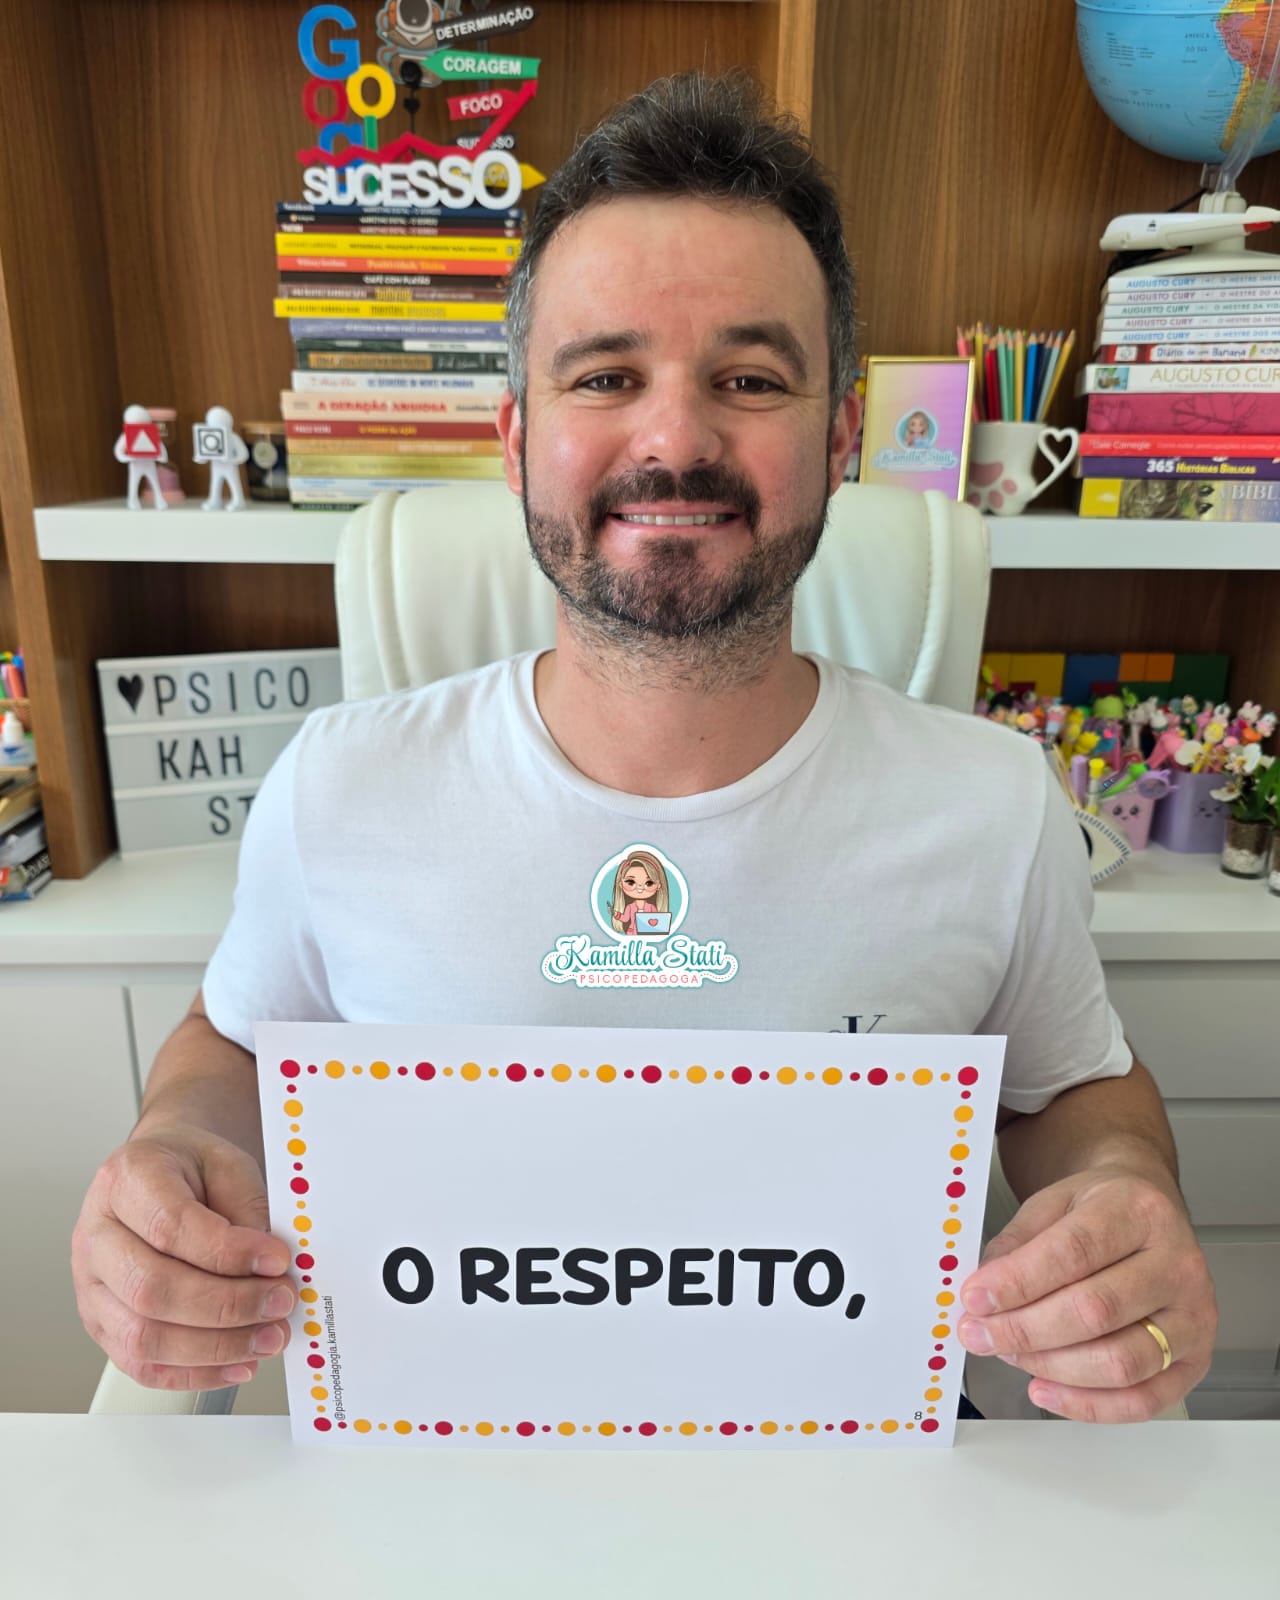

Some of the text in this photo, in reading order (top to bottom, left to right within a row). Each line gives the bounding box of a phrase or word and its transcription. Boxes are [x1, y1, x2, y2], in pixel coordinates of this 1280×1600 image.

[436, 6, 534, 42] DETERMINAÇÃO
[443, 56, 522, 75] CORAGEM
[460, 94, 503, 115] FOCO
[303, 150, 521, 210] SUCESSO
[1127, 279, 1169, 288] AUGUSTO
[1171, 278, 1195, 286] CURY
[1127, 293, 1169, 302] AUGUSTO
[1171, 292, 1195, 300] CURY
[1121, 306, 1164, 315] AUGUSTO
[1166, 305, 1190, 313] CURY
[1125, 319, 1168, 327] AUGUSTO
[1169, 318, 1193, 326] CURY
[1122, 332, 1164, 341] AUGUSTO
[1166, 331, 1190, 340] CURY
[1157, 348, 1183, 357] Diário
[1212, 347, 1246, 357] Banana
[1151, 367, 1241, 383] AUGUSTO
[1113, 441, 1152, 452] Carnegie
[1147, 460, 1175, 473] 365
[154, 666, 310, 716] PSICO
[157, 735, 243, 781] KAH
[382, 1247, 866, 1320] O RESPEITO,
[322, 1295, 346, 1421] @psicopedagogia.kamillastati
[914, 1411, 923, 1420] 8
